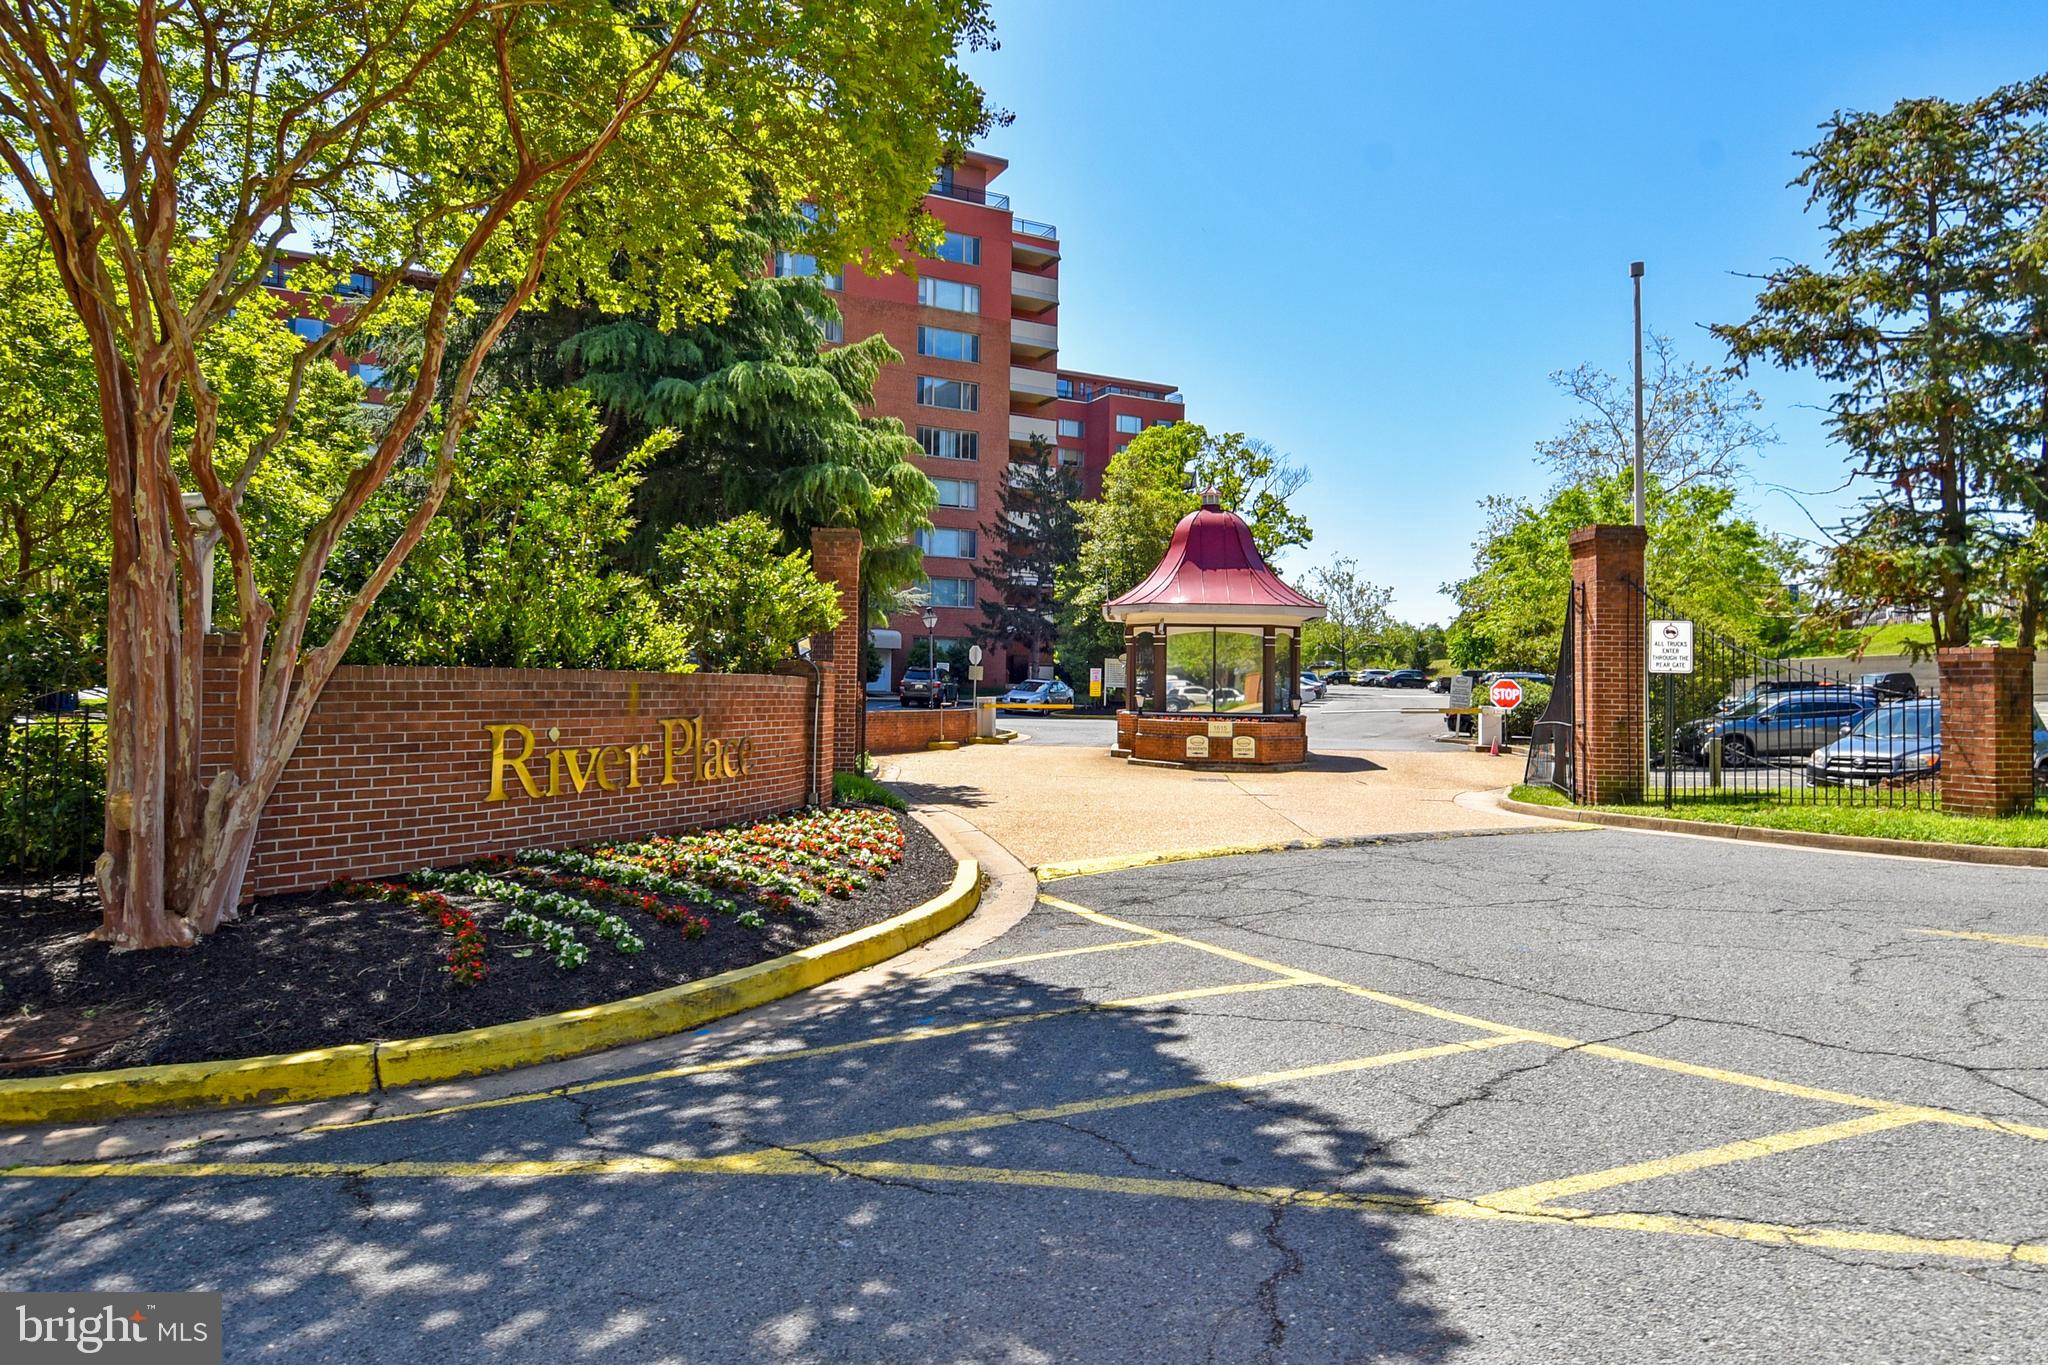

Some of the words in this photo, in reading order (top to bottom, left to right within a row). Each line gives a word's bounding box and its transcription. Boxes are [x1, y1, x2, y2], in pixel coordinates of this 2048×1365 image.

[1492, 688, 1520, 700] STOP
[483, 723, 650, 802] River
[656, 714, 754, 786] Place
